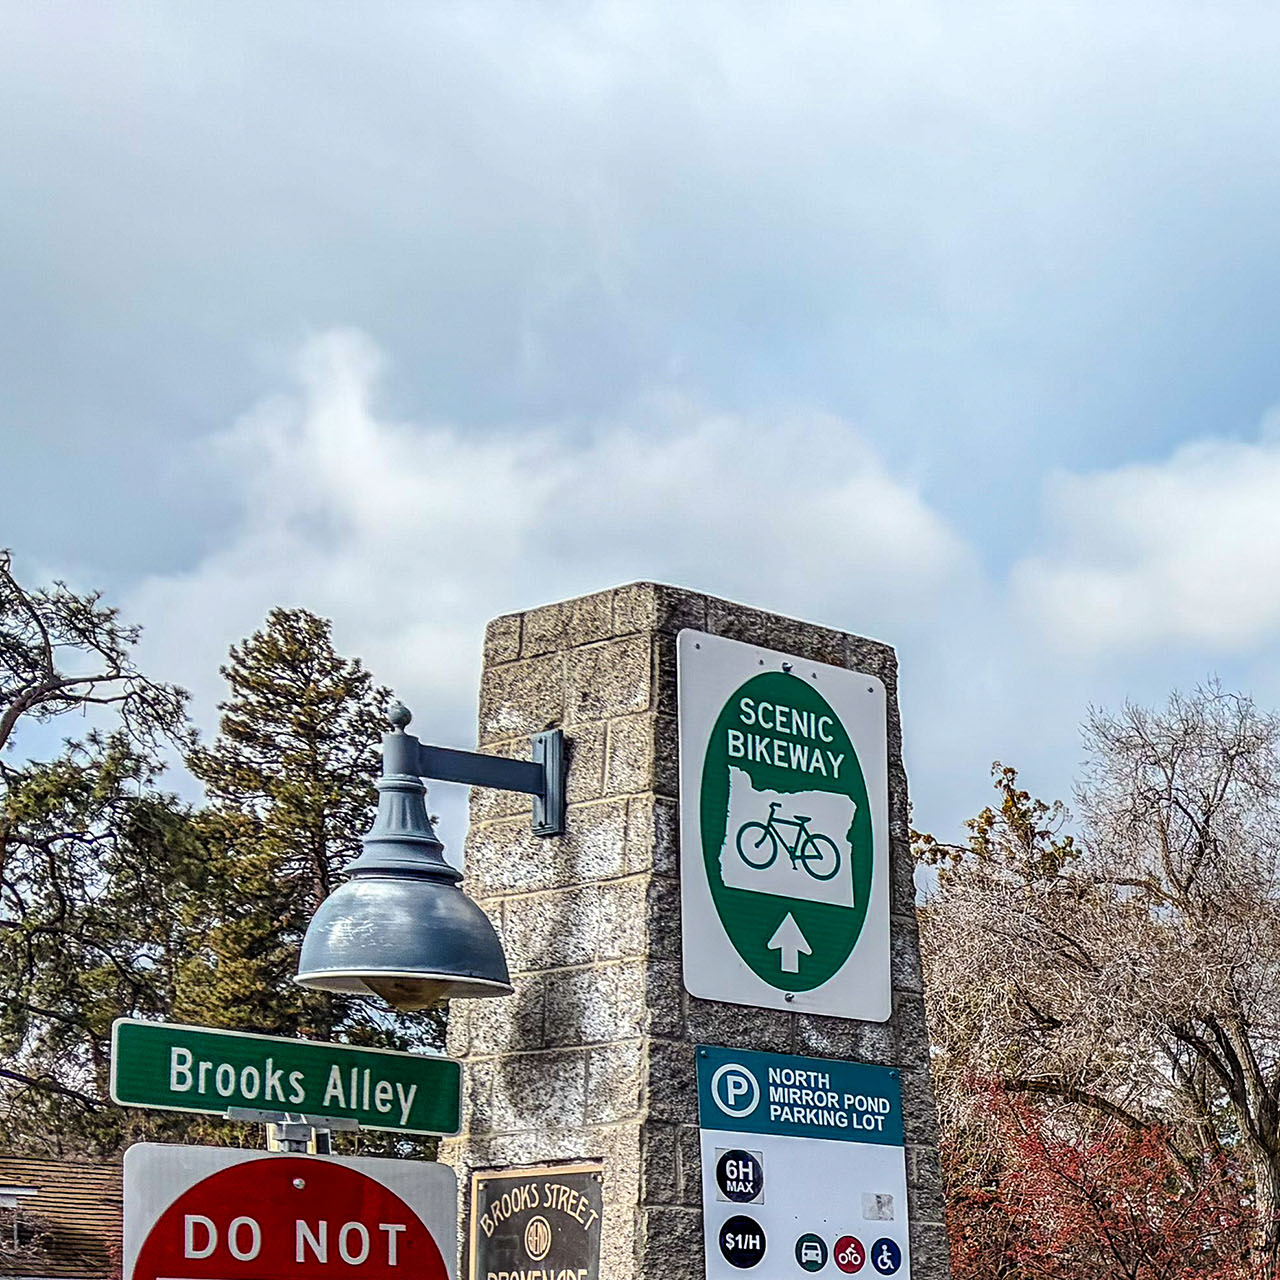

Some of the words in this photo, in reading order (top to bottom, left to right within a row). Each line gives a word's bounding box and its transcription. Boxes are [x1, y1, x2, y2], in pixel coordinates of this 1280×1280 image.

[739, 697, 834, 743] SCENIC
[727, 728, 845, 779] BIKEWAY
[169, 1046, 305, 1105] Brooks
[322, 1064, 417, 1126] Alley
[726, 1075, 748, 1105] P
[768, 1067, 830, 1089] NORTH
[769, 1086, 839, 1108] MIRROR
[844, 1094, 890, 1114] POND
[770, 1105, 848, 1128] PARKING
[853, 1113, 885, 1131] LOT
[725, 1159, 754, 1181] 6H
[726, 1180, 754, 1194] MAX
[479, 1183, 540, 1238] BROOKS
[543, 1182, 599, 1231] STREET
[184, 1214, 262, 1261] DO
[295, 1220, 407, 1266] NOT
[725, 1232, 761, 1251] $1/H
